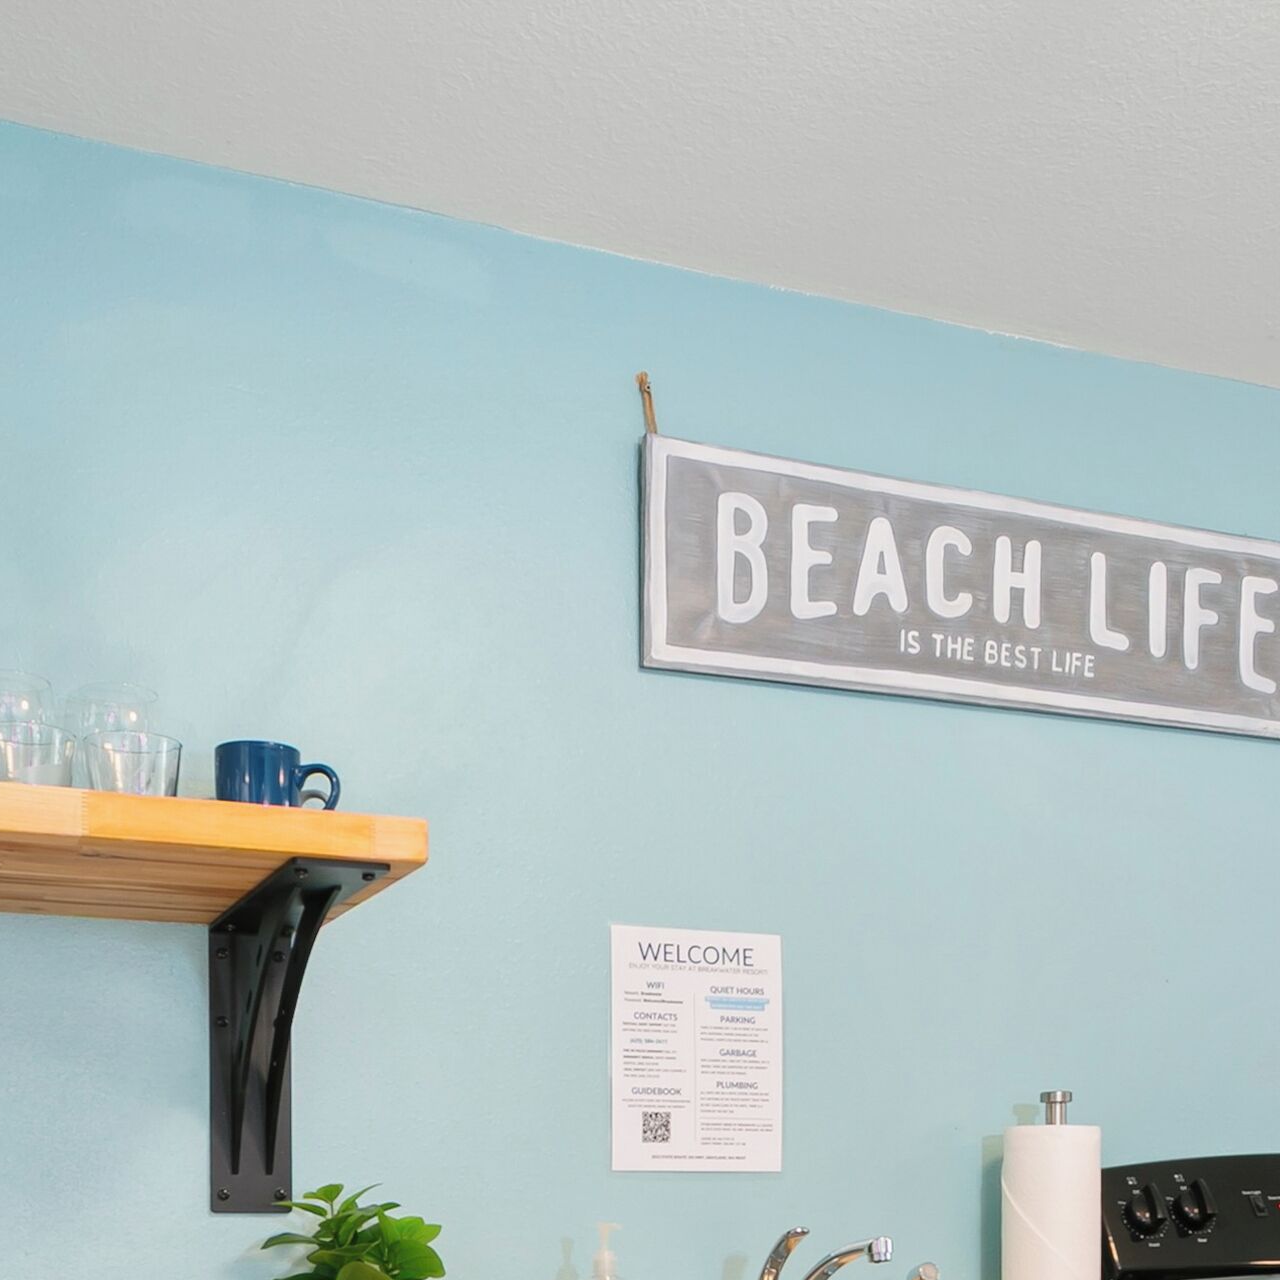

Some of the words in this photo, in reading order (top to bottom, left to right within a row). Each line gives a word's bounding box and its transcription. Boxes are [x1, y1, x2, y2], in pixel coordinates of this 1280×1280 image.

[717, 491, 1042, 629] BEACH
[1090, 551, 1280, 695] LIFE
[900, 629, 921, 655] IS
[932, 633, 975, 662] THE
[984, 640, 1042, 670] BEST
[1051, 650, 1096, 678] LIFE
[638, 941, 755, 966] WELCOME
[628, 962, 650, 970] ENJOY
[651, 963, 669, 971] YOUR
[646, 981, 665, 990] WIFI
[709, 985, 734, 995] QUIET
[736, 987, 765, 996] HOURS
[633, 1011, 678, 1021] CONTACTS
[720, 1015, 756, 1025] PARKING
[719, 1048, 757, 1058] GARBAGE
[716, 1080, 758, 1090] PLUMBING
[631, 1086, 682, 1096] GUIDEBOOK
